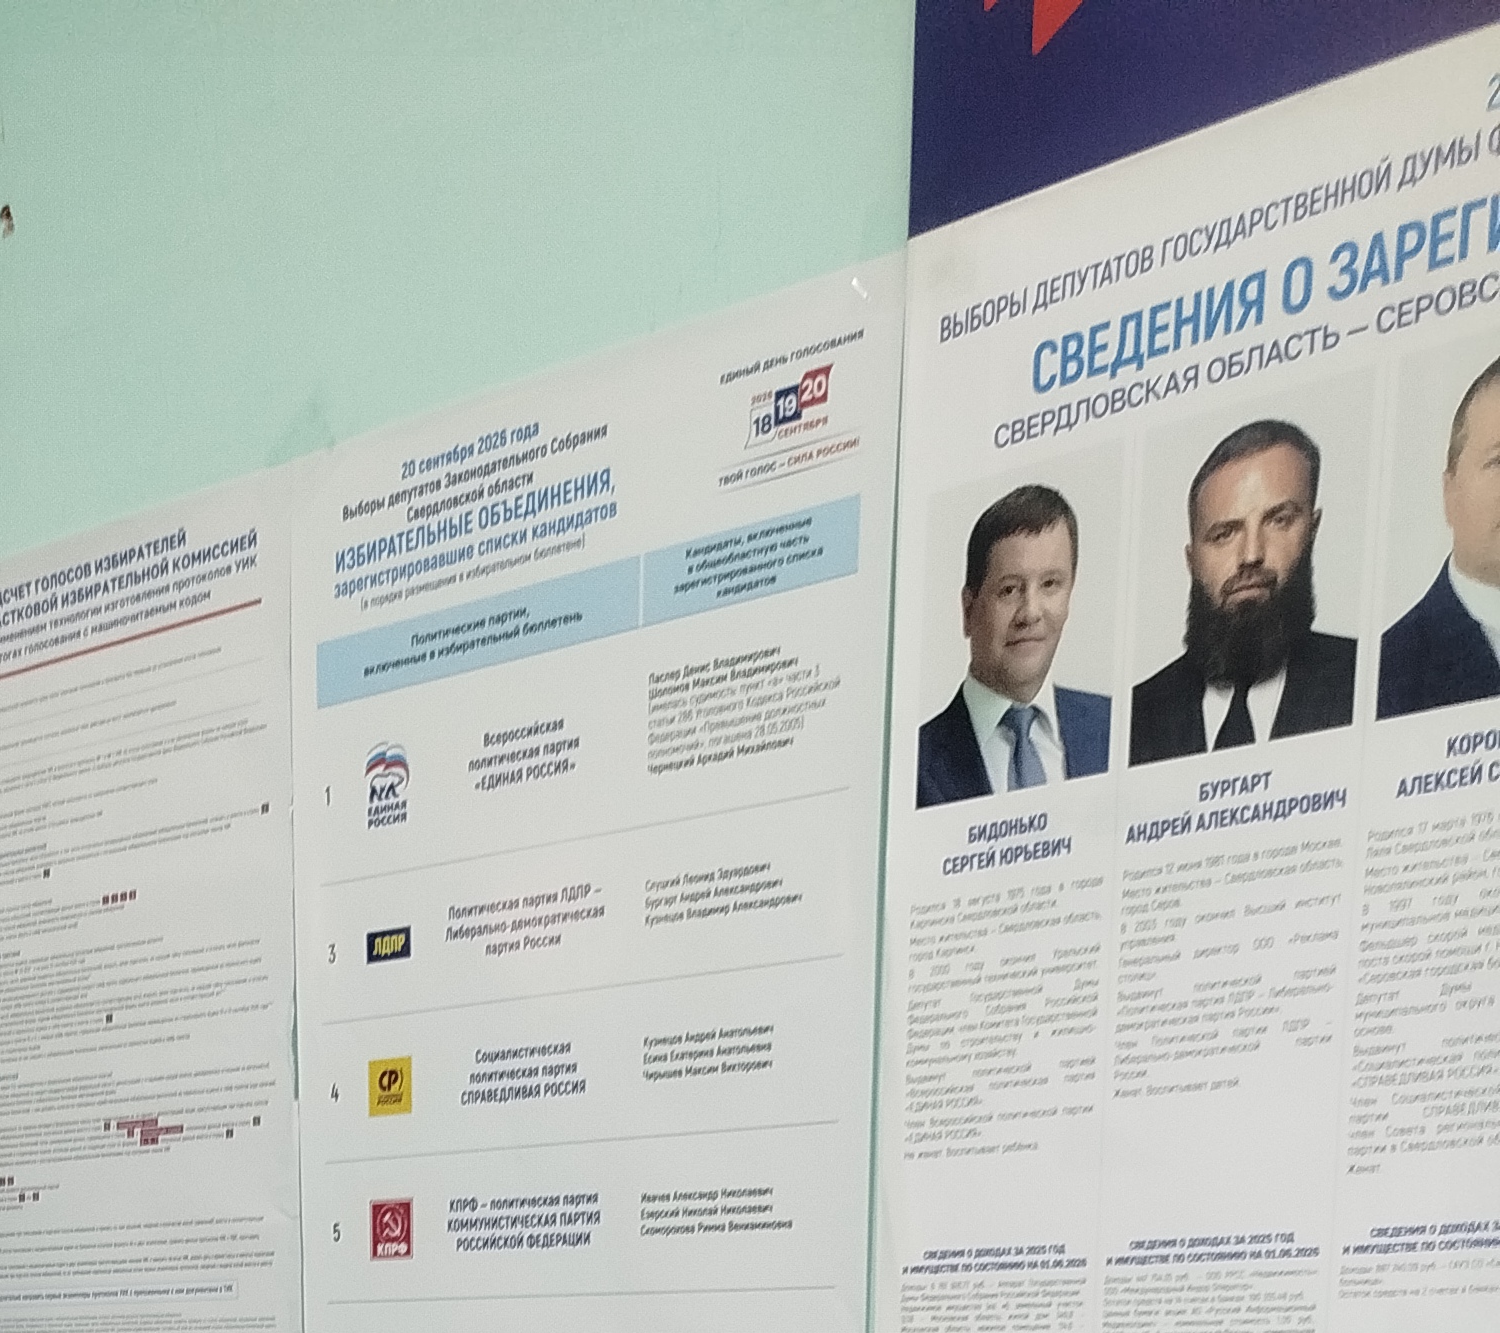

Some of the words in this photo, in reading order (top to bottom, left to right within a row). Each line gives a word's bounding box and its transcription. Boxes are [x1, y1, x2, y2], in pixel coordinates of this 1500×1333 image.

[939, 286, 1028, 344] ВЫБОРЫ
[1031, 244, 1154, 314] ДЕПУТАТОВ
[1159, 156, 1392, 267] ГОСУДАРСТВЕННОЙ
[1396, 128, 1482, 187] ДУМЫ
[1031, 268, 1267, 394] СВЕДЕНИЯ
[1281, 255, 1313, 315] О
[719, 359, 761, 385] ЕДИНЫЙ
[761, 354, 789, 373] ДЕНЬ
[789, 328, 864, 362] ГОЛОСОВАНИЯ
[993, 362, 1200, 449] СВЕРДЛОВСКАЯ
[1206, 323, 1340, 384] ОБЛАСТЬ
[753, 412, 773, 437] 18
[777, 393, 798, 420] 19
[801, 372, 826, 402] 20
[400, 458, 416, 481] 20
[417, 442, 474, 474] сентября
[509, 421, 539, 445] года
[341, 495, 385, 522] Выборы
[386, 477, 442, 510] депутатов
[443, 443, 548, 489] Законодательного
[549, 425, 608, 455] Собрания
[406, 483, 485, 523] Свердловской
[486, 470, 535, 498] области
[335, 508, 473, 574] ИЗБИРАТЕЛЬНЫЕ
[477, 468, 615, 530] ОБЪЕДИНЕНИЯ,
[33, 561, 92, 595] ГОЛОСОВ
[93, 528, 186, 576] ИЗБИРАТЕЛЕЙ
[333, 543, 474, 599] зарегистрировавшие
[477, 527, 528, 556] списки
[531, 501, 617, 541] кандидатов
[60, 555, 169, 609] ИЗБИРАТЕЛЬНОЙ
[171, 528, 257, 574] КОМИССИЕЙ
[715, 574, 777, 598] кандидатов
[363, 650, 427, 678] включенные
[428, 649, 436, 660] в
[436, 623, 520, 659] избирательный
[521, 611, 583, 636] бюллетень
[410, 617, 486, 647] Политические
[482, 717, 564, 748] Всероссийская
[1445, 728, 1500, 758] КОРО
[467, 744, 540, 772] политическая
[542, 736, 580, 756] партия
[474, 767, 523, 791] «ЕДИНАЯ
[525, 759, 576, 782] РОССИЯ»
[1198, 769, 1272, 802] БУРГАРТ
[1395, 761, 1483, 798] АЛЕКСЕЙ
[967, 812, 1048, 844] БИДОНЬКО
[1124, 813, 1192, 844] АНДРЕЙ
[1194, 787, 1347, 832] АЛЕКСАНДРОВИЧ
[942, 848, 996, 876] СЕРГЕЙ
[998, 836, 1072, 866] ЮРЬЕВИЧ
[447, 897, 520, 921] Политическая
[521, 890, 558, 909] партия
[559, 883, 591, 903] ЛДПР
[444, 904, 605, 942] Либерально-демократическая
[328, 943, 337, 964] 3
[373, 934, 405, 957] ЛДПР
[484, 939, 521, 956] партия
[522, 933, 562, 950] России
[474, 1041, 571, 1064] Социалистическая
[468, 1065, 539, 1085] политическая
[540, 1061, 577, 1078] партия
[330, 1083, 339, 1102] 4
[460, 1082, 541, 1106] СПРАВЕДЛИВАЯ
[543, 1078, 586, 1097] РОССИЯ
[448, 1196, 478, 1213] КПРФ
[489, 1194, 560, 1211] политическая
[562, 1192, 599, 1209] партия
[333, 1222, 341, 1242] 5
[446, 1211, 557, 1233] КОММУНИСТИЧЕСКАЯ
[559, 1209, 600, 1227] ПАРТИЯ
[376, 1242, 408, 1257] КПРФ
[455, 1232, 524, 1252] РОССИЙСКОЙ
[525, 1230, 591, 1249] ФЕДЕРАЦИИ
